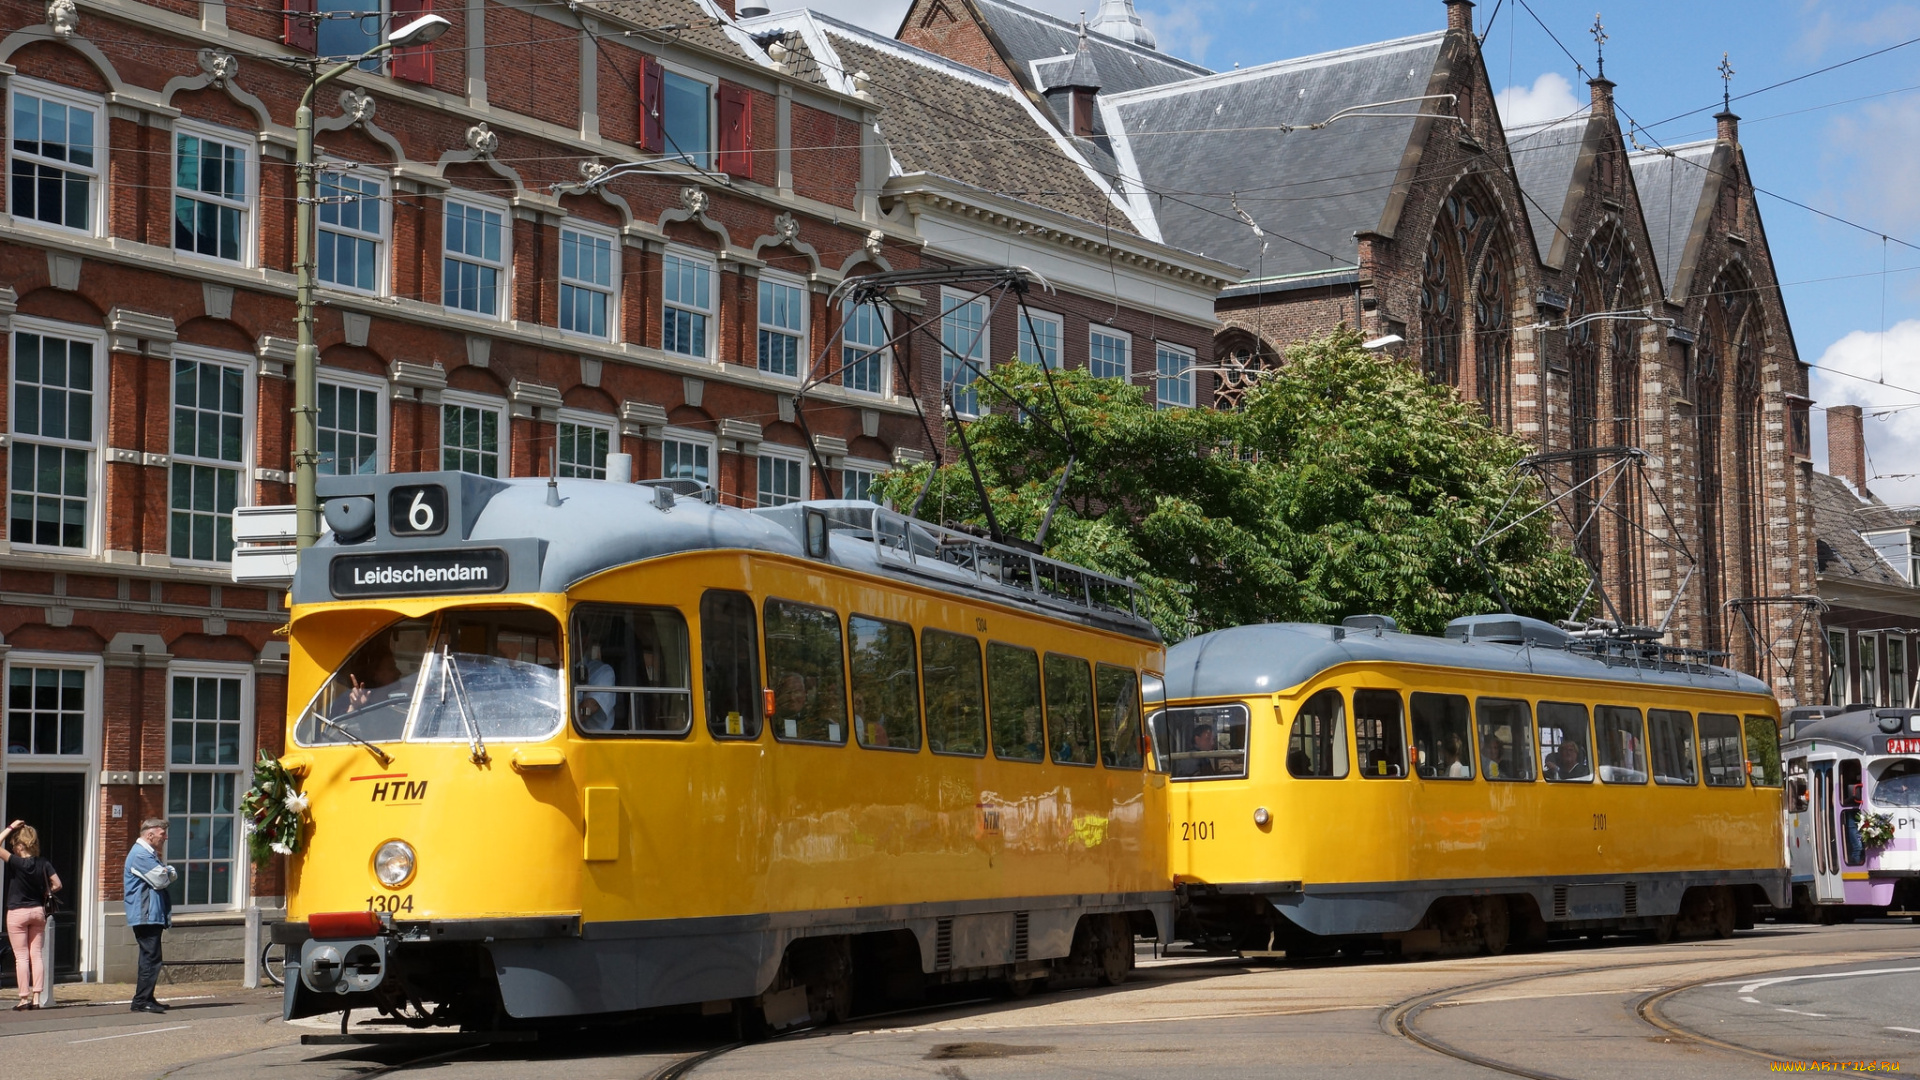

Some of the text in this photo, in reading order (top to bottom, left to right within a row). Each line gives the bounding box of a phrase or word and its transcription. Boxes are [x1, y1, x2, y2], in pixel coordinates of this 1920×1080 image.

[409, 490, 434, 531] 6
[354, 563, 488, 585] Leidschendam
[371, 780, 428, 802] HTM
[1181, 821, 1215, 841] 2101
[1593, 813, 1607, 831] 2101
[1898, 817, 1916, 830] P1
[366, 895, 414, 914] 1304
